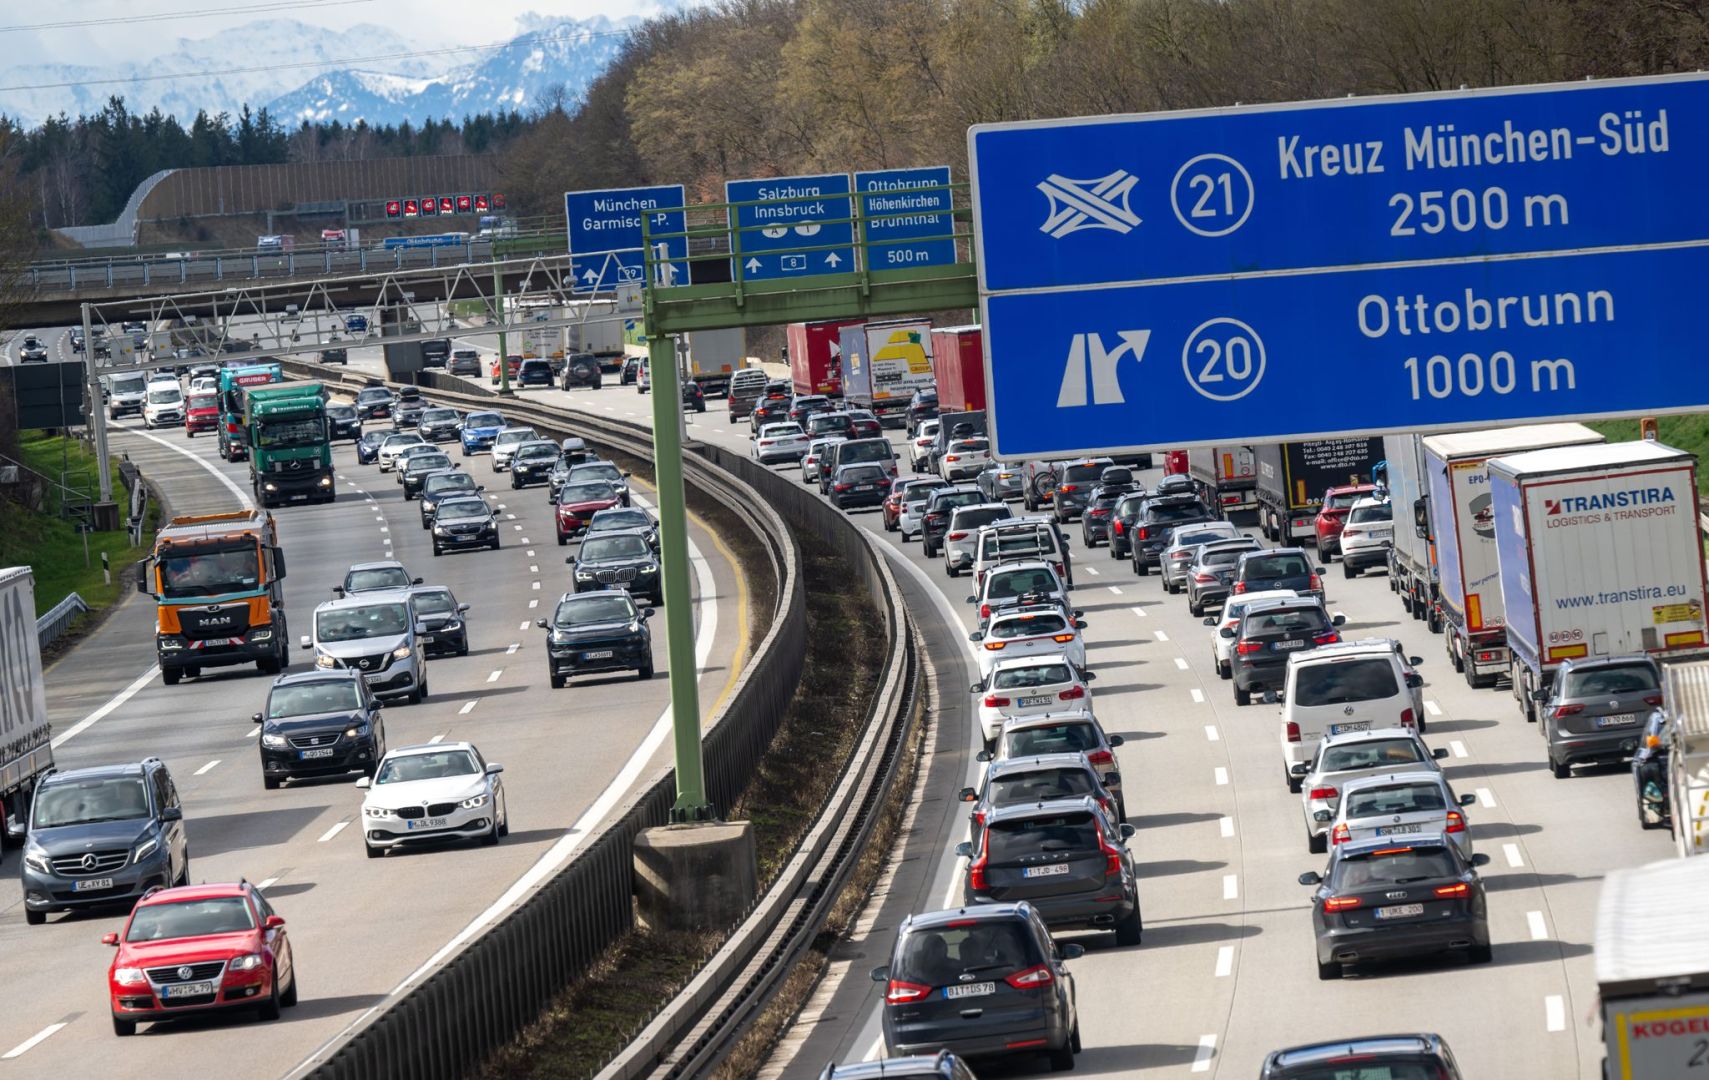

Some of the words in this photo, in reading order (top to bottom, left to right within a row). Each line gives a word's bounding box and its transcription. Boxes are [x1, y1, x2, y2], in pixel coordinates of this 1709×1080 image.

[1279, 135, 1384, 178] Kreuz
[1404, 110, 1669, 171] München-Süd
[758, 186, 820, 200] Salzburg
[1189, 173, 1233, 217] 21
[594, 198, 657, 212] München
[755, 202, 825, 219] Innsbruck
[869, 195, 940, 211] Höhenkirchen
[1389, 187, 1508, 236] 2500
[1524, 194, 1568, 227] m
[583, 213, 670, 231] Garmisc-P.
[871, 214, 939, 229] Brunnthal
[790, 257, 797, 267] 8
[888, 249, 913, 263] 500
[915, 250, 929, 261] m
[1358, 288, 1614, 338] Ottobrunn
[1196, 336, 1252, 383] 20
[239, 376, 267, 384] GRUBER
[1405, 351, 1515, 400] 1000
[1531, 358, 1575, 392] m
[1562, 487, 1675, 513] TRANSTIRA
[1546, 514, 1601, 529] LOGISTICS
[1604, 513, 1612, 522] &
[1614, 505, 1677, 521] TRANSPORT
[1555, 584, 1687, 610] www.transtira.eu
[199, 616, 231, 627] MAN
[948, 986, 965, 997] BIT
